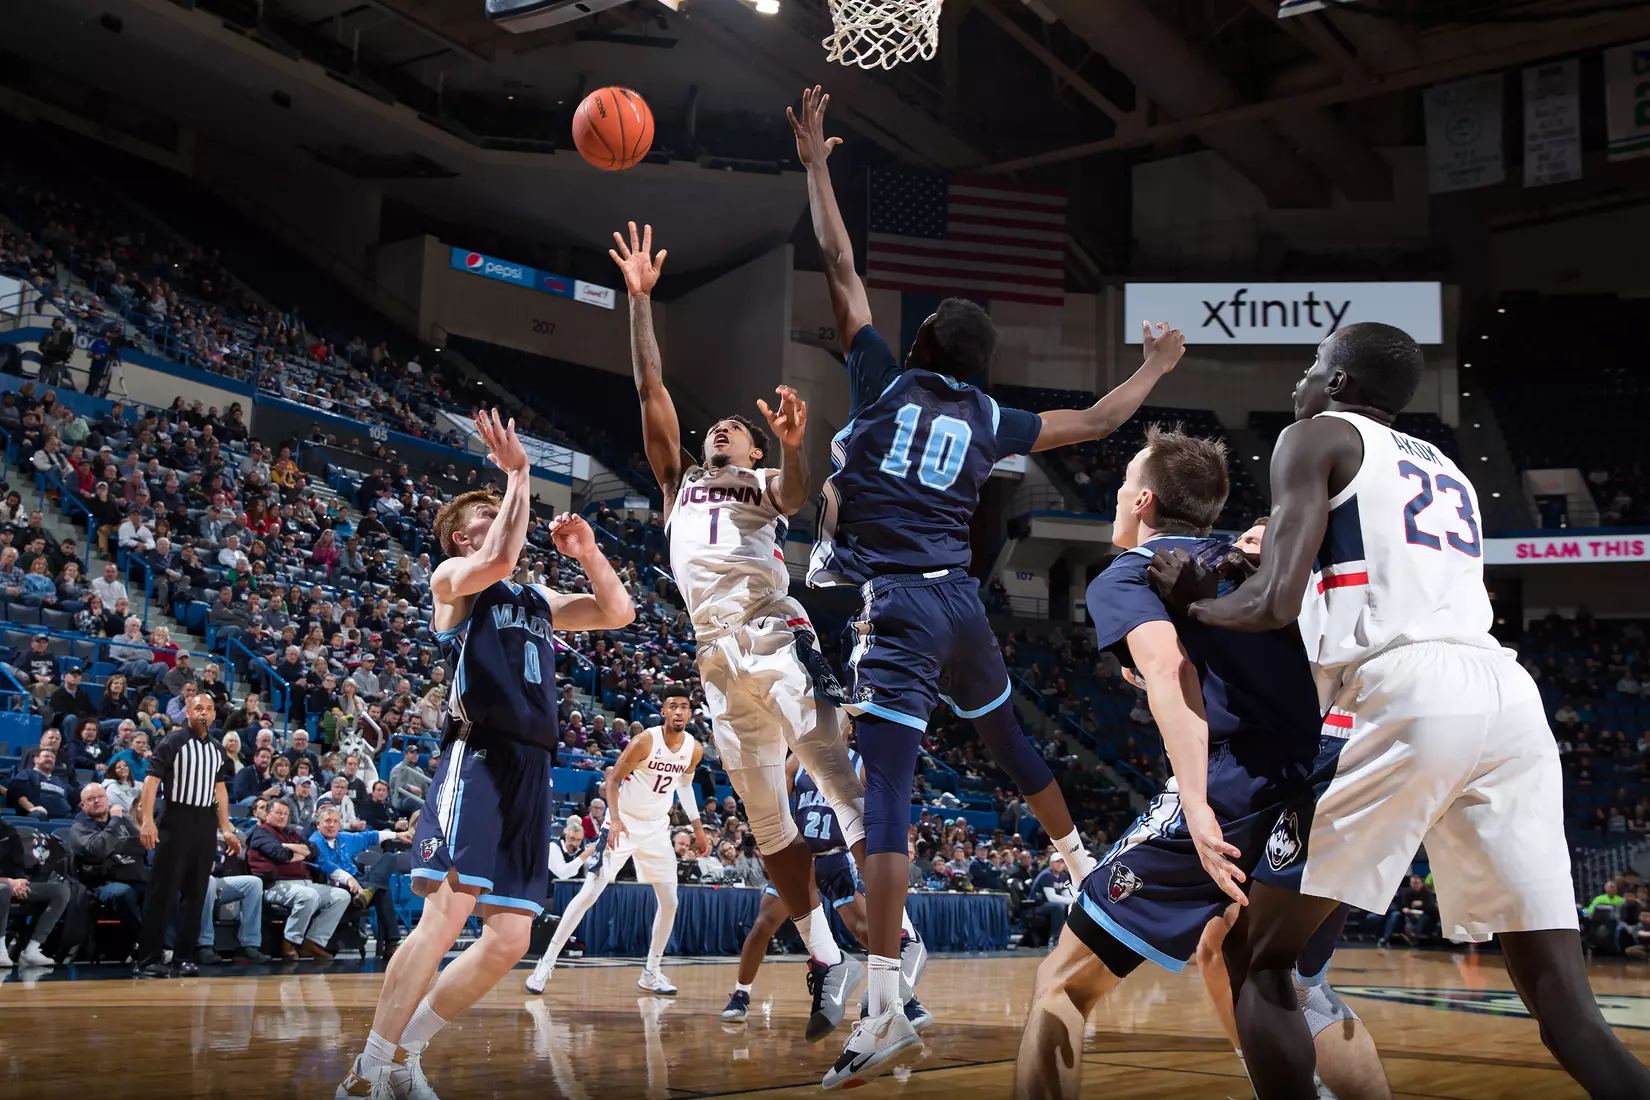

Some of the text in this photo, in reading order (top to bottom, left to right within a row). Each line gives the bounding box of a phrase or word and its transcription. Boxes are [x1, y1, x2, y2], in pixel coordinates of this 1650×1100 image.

[485, 262, 523, 280] pepsi
[1201, 288, 1352, 338] xfinity
[532, 319, 556, 335] 207
[369, 426, 388, 442] 105
[879, 402, 973, 492] 10
[1390, 431, 1443, 467] AKOK
[681, 486, 763, 507] UCONN
[1397, 459, 1482, 558] 23
[708, 507, 721, 545] 1
[1516, 540, 1645, 559] SLAM THIS
[1016, 571, 1035, 581] 107
[524, 640, 542, 685] 0
[648, 760, 687, 774] UCONN
[652, 774, 673, 794] 12
[804, 811, 832, 840] 21
